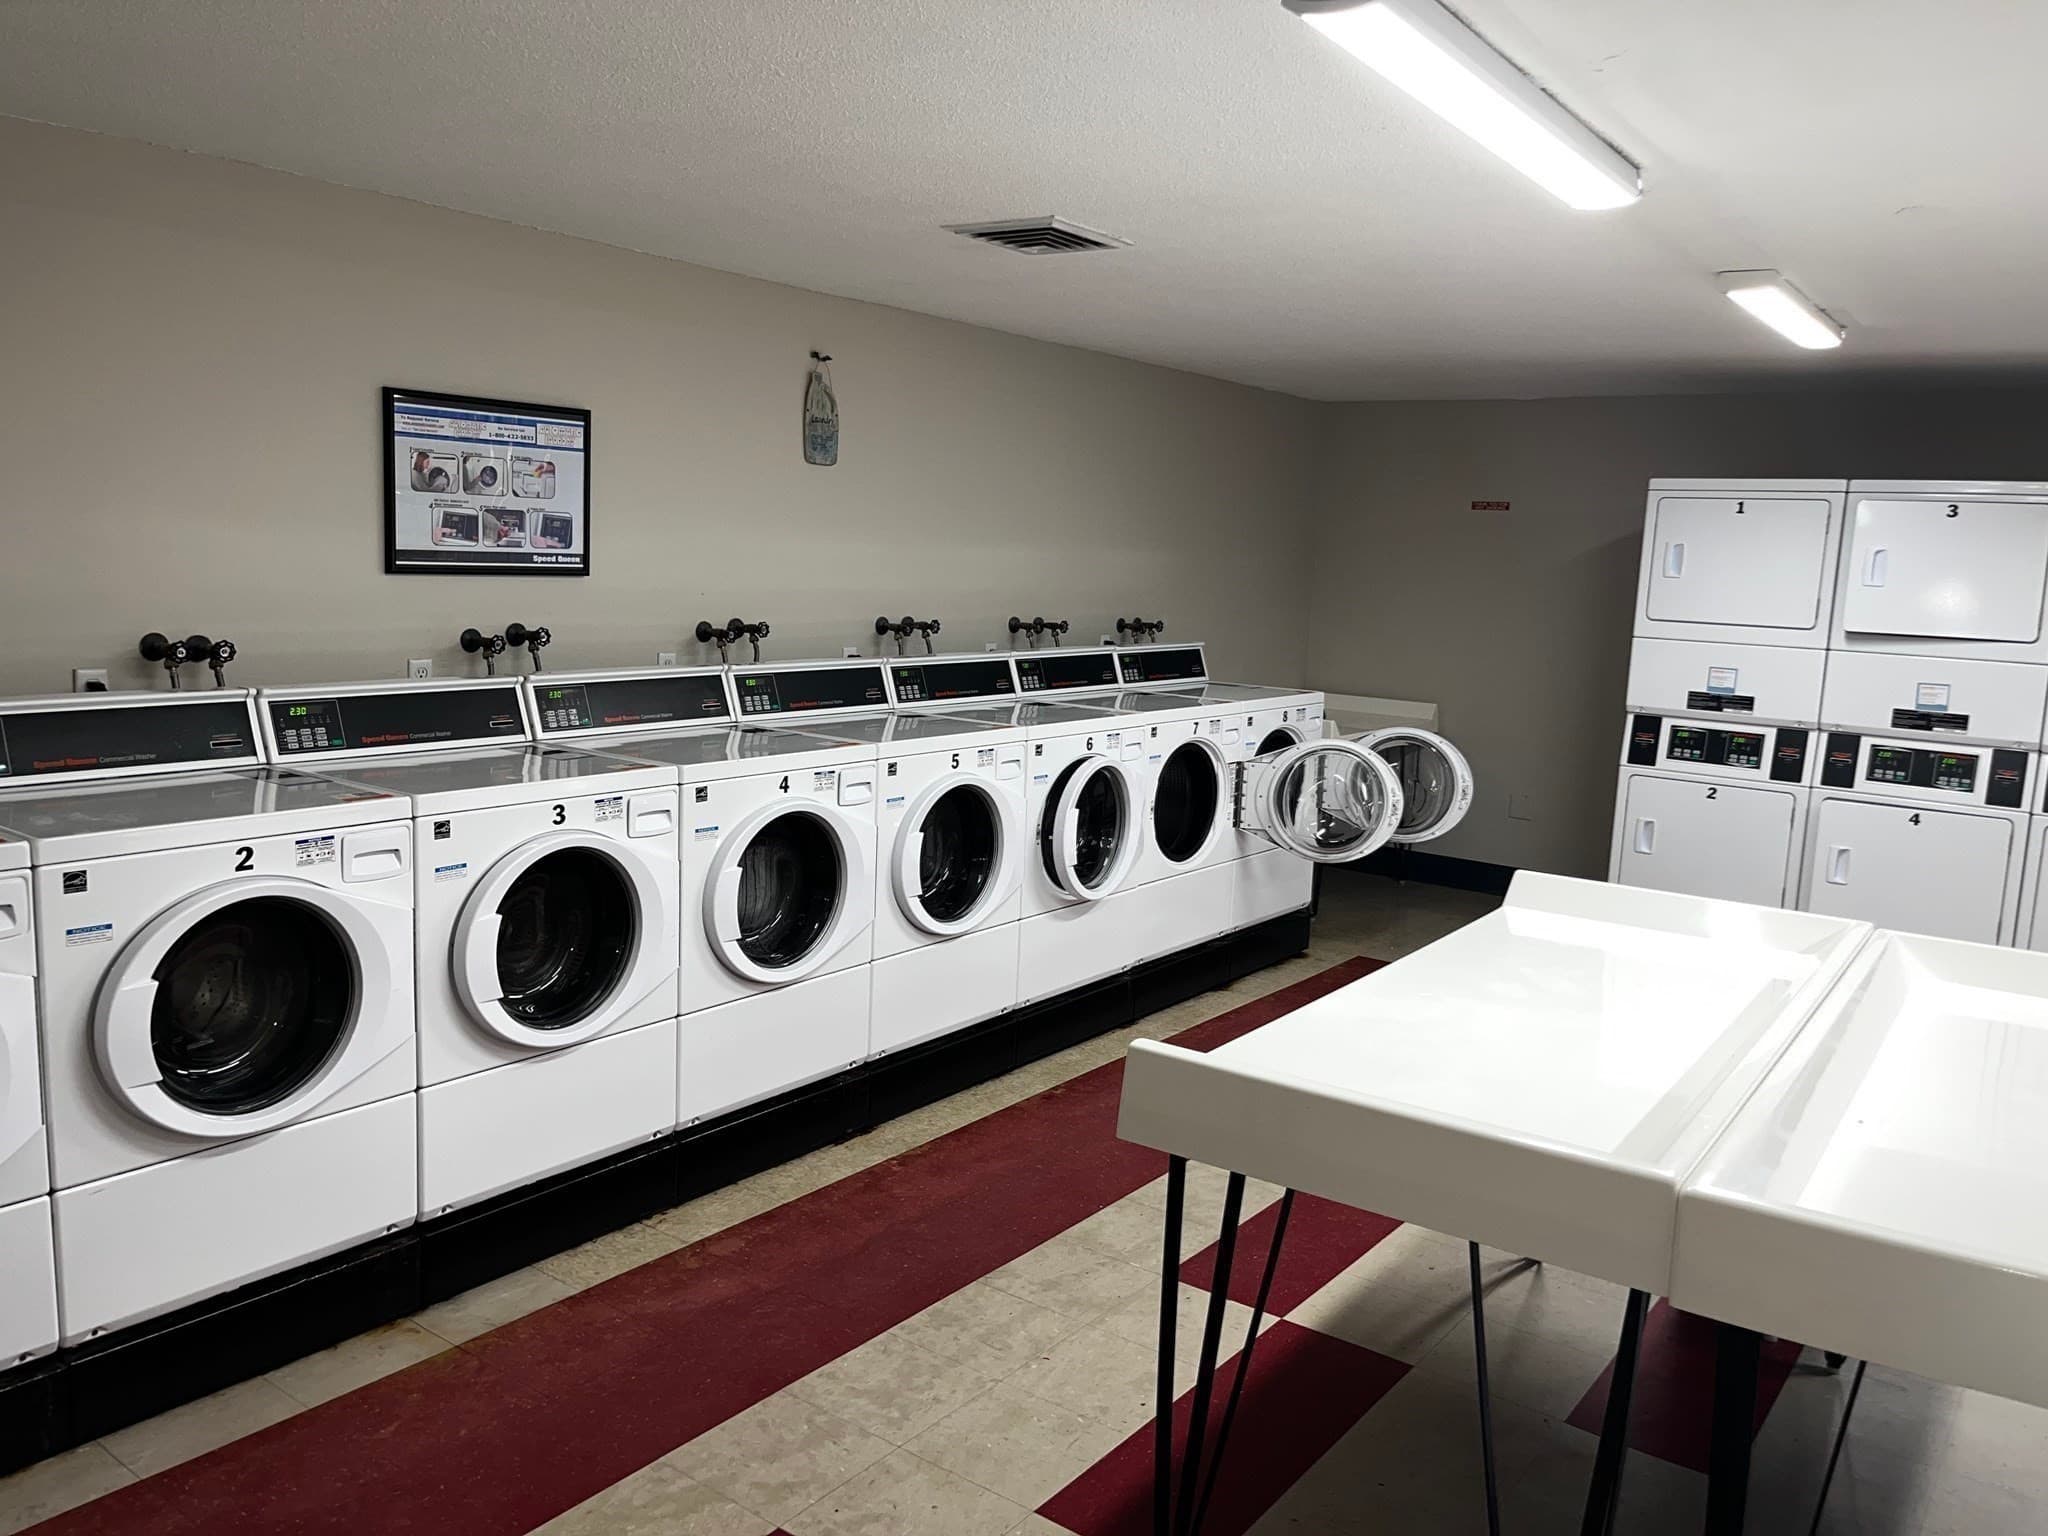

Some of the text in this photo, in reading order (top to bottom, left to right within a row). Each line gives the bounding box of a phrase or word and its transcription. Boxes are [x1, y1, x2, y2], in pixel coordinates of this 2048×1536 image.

[1736, 501, 1744, 514] 1
[1946, 504, 1959, 518] 3
[533, 555, 556, 564] Speed
[1282, 710, 1288, 722] 8
[1193, 722, 1199, 734] 7
[1086, 737, 1093, 750] 6
[952, 754, 960, 769] 5
[779, 776, 790, 793] 4
[1706, 787, 1718, 800] 2
[552, 804, 566, 826] 3
[1908, 813, 1921, 826] 4
[234, 846, 254, 872] 2
